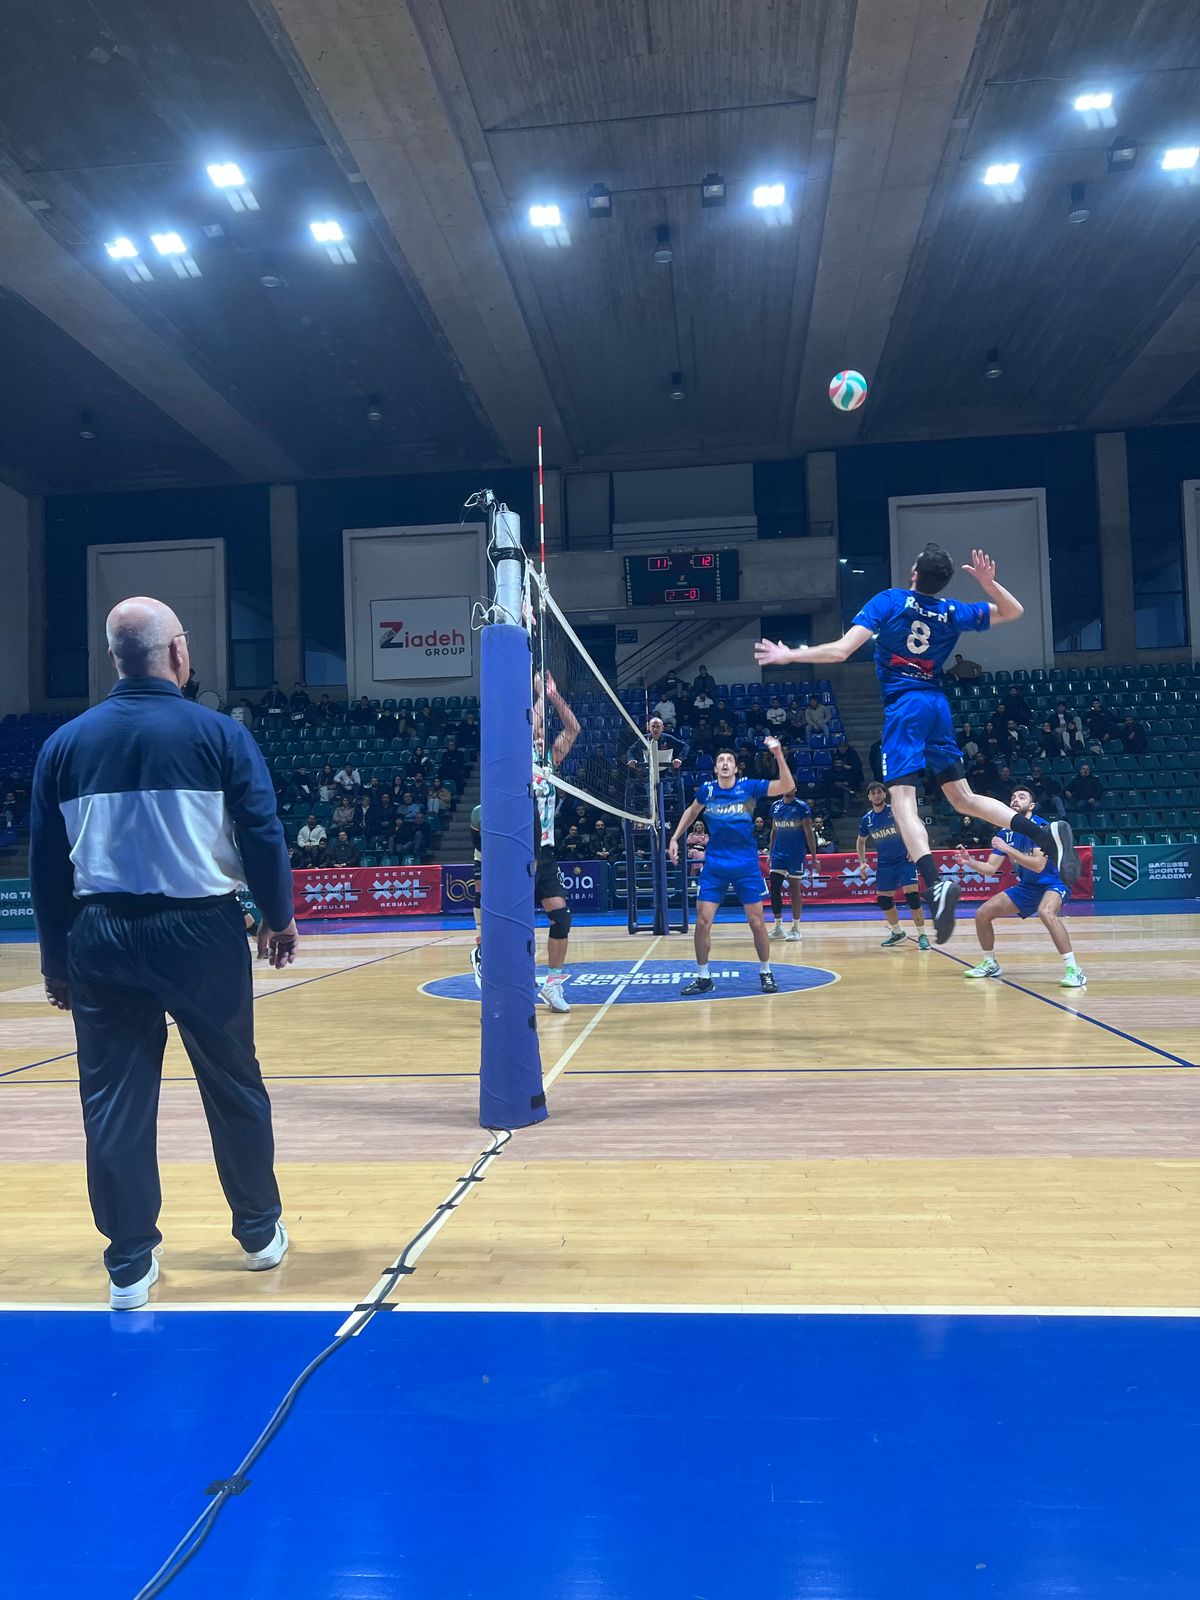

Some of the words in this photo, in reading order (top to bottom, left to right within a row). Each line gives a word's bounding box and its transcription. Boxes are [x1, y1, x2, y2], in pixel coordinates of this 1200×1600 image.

[657, 559, 667, 569] 11
[702, 556, 711, 566] 12
[379, 621, 465, 649] Ziadeh
[906, 620, 931, 654] 8
[425, 647, 465, 656] GROUP
[304, 882, 358, 903] XXL
[372, 879, 428, 900] XXL
[0, 908, 34, 917] ORRO
[570, 976, 682, 986] School
